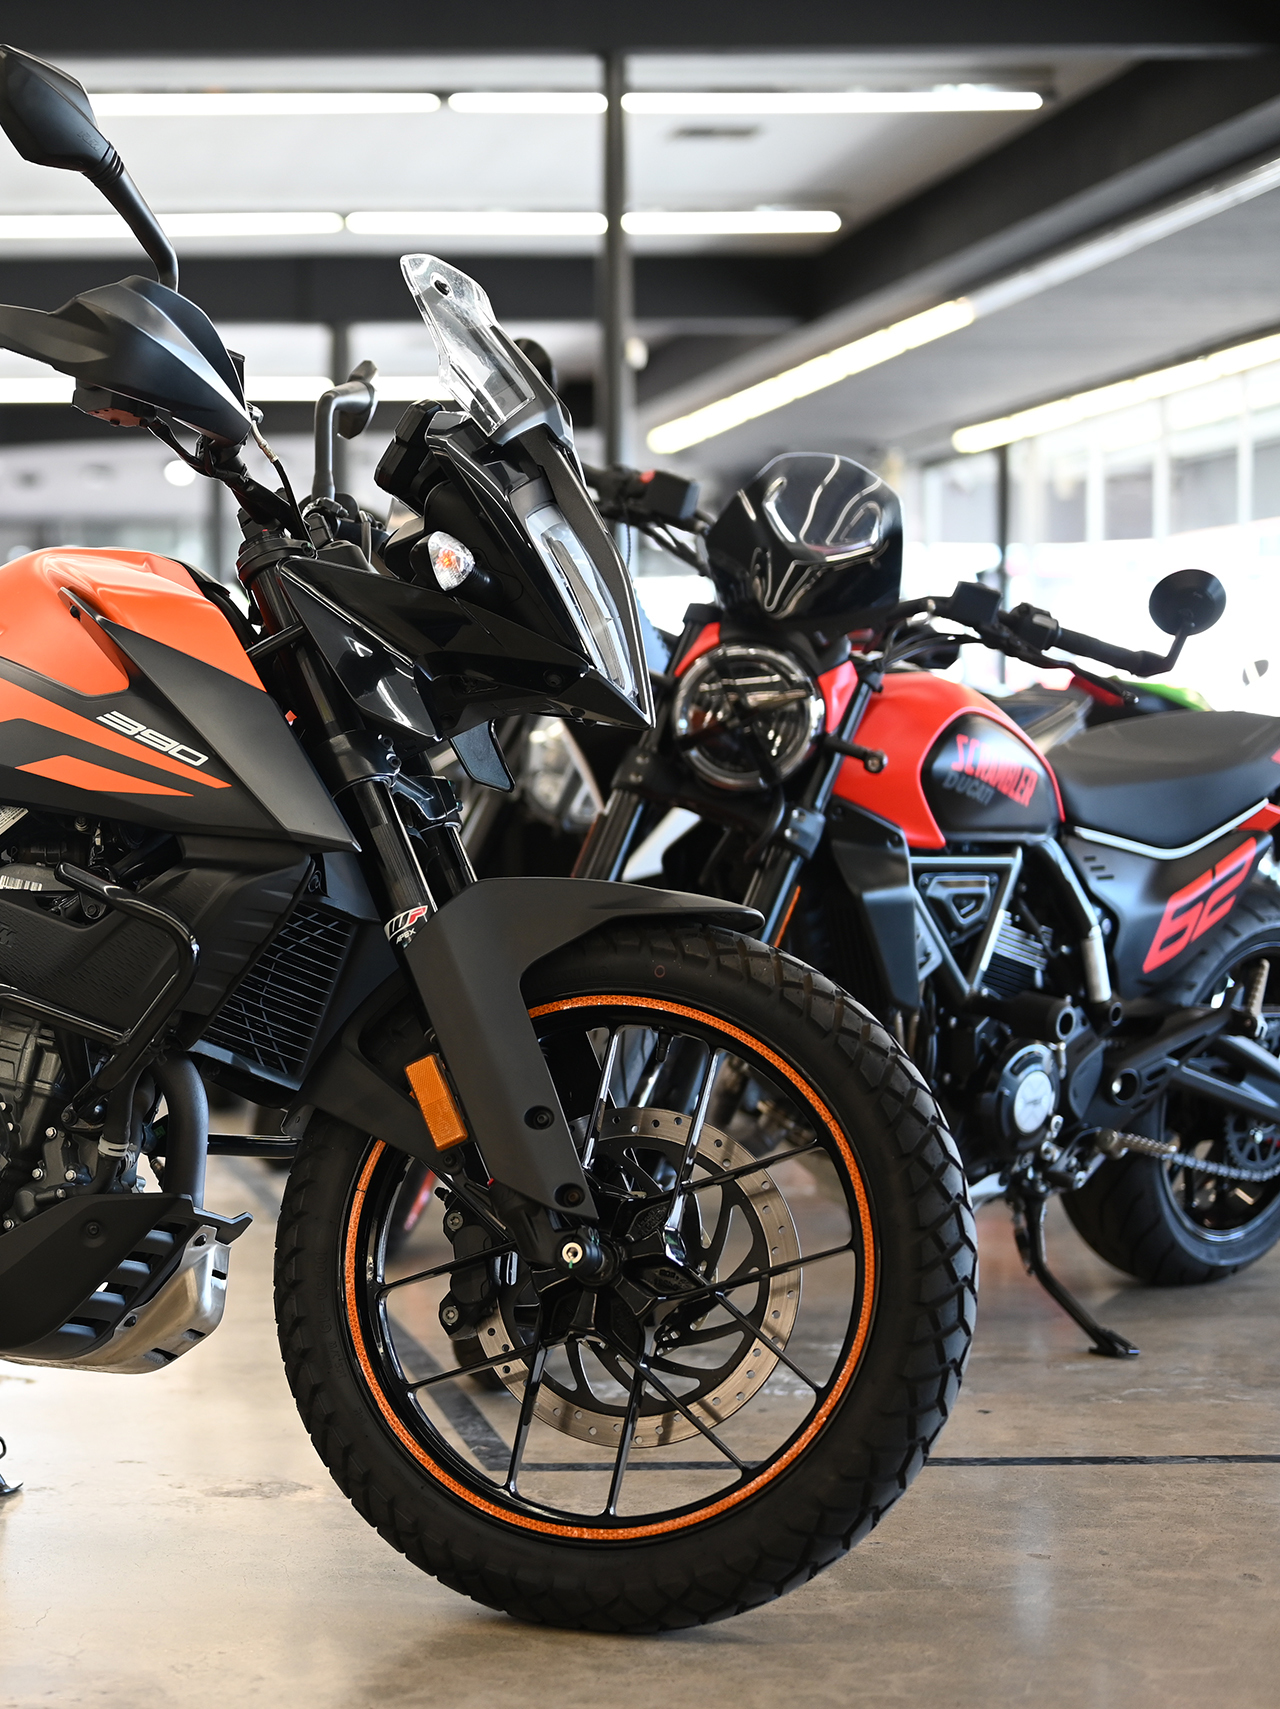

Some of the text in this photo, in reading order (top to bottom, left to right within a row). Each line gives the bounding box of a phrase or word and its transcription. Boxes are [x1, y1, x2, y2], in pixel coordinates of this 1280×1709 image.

[96, 710, 209, 767] 390
[942, 769, 996, 806] DUCATI
[951, 733, 1038, 808] SCRAMBLER
[1142, 836, 1257, 974] 62
[396, 928, 417, 944] APEX
